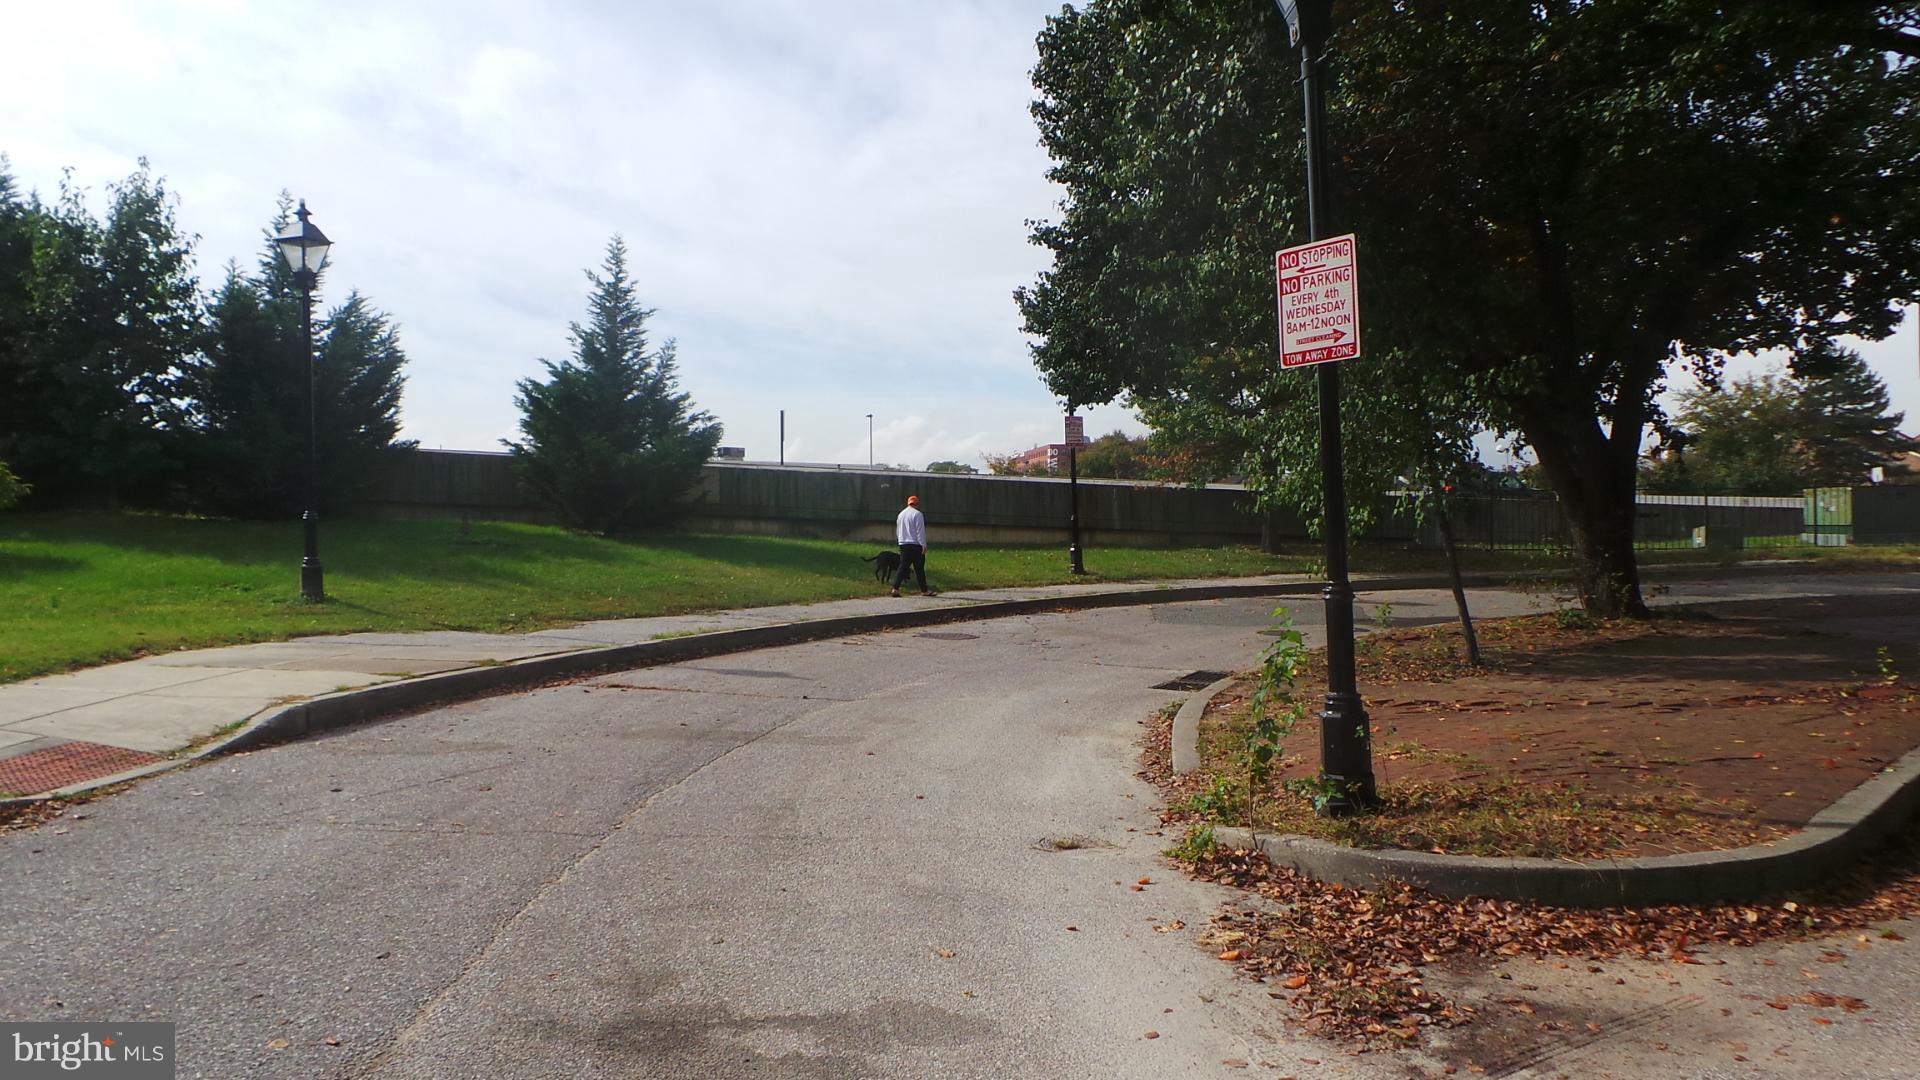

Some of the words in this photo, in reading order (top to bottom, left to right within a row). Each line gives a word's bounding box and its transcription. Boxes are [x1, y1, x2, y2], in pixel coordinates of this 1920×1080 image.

[1281, 253, 1297, 269] NO
[1301, 243, 1349, 265] STOPPING
[1282, 279, 1298, 294] NO
[1302, 268, 1350, 290] PARKING
[1291, 291, 1319, 306] EVERY
[1324, 287, 1339, 300] 4th
[1286, 299, 1346, 320] WEDNESDAY
[1285, 354, 1302, 365] TOW
[1304, 348, 1328, 362] AWAY
[1331, 344, 1354, 358] ZONE
